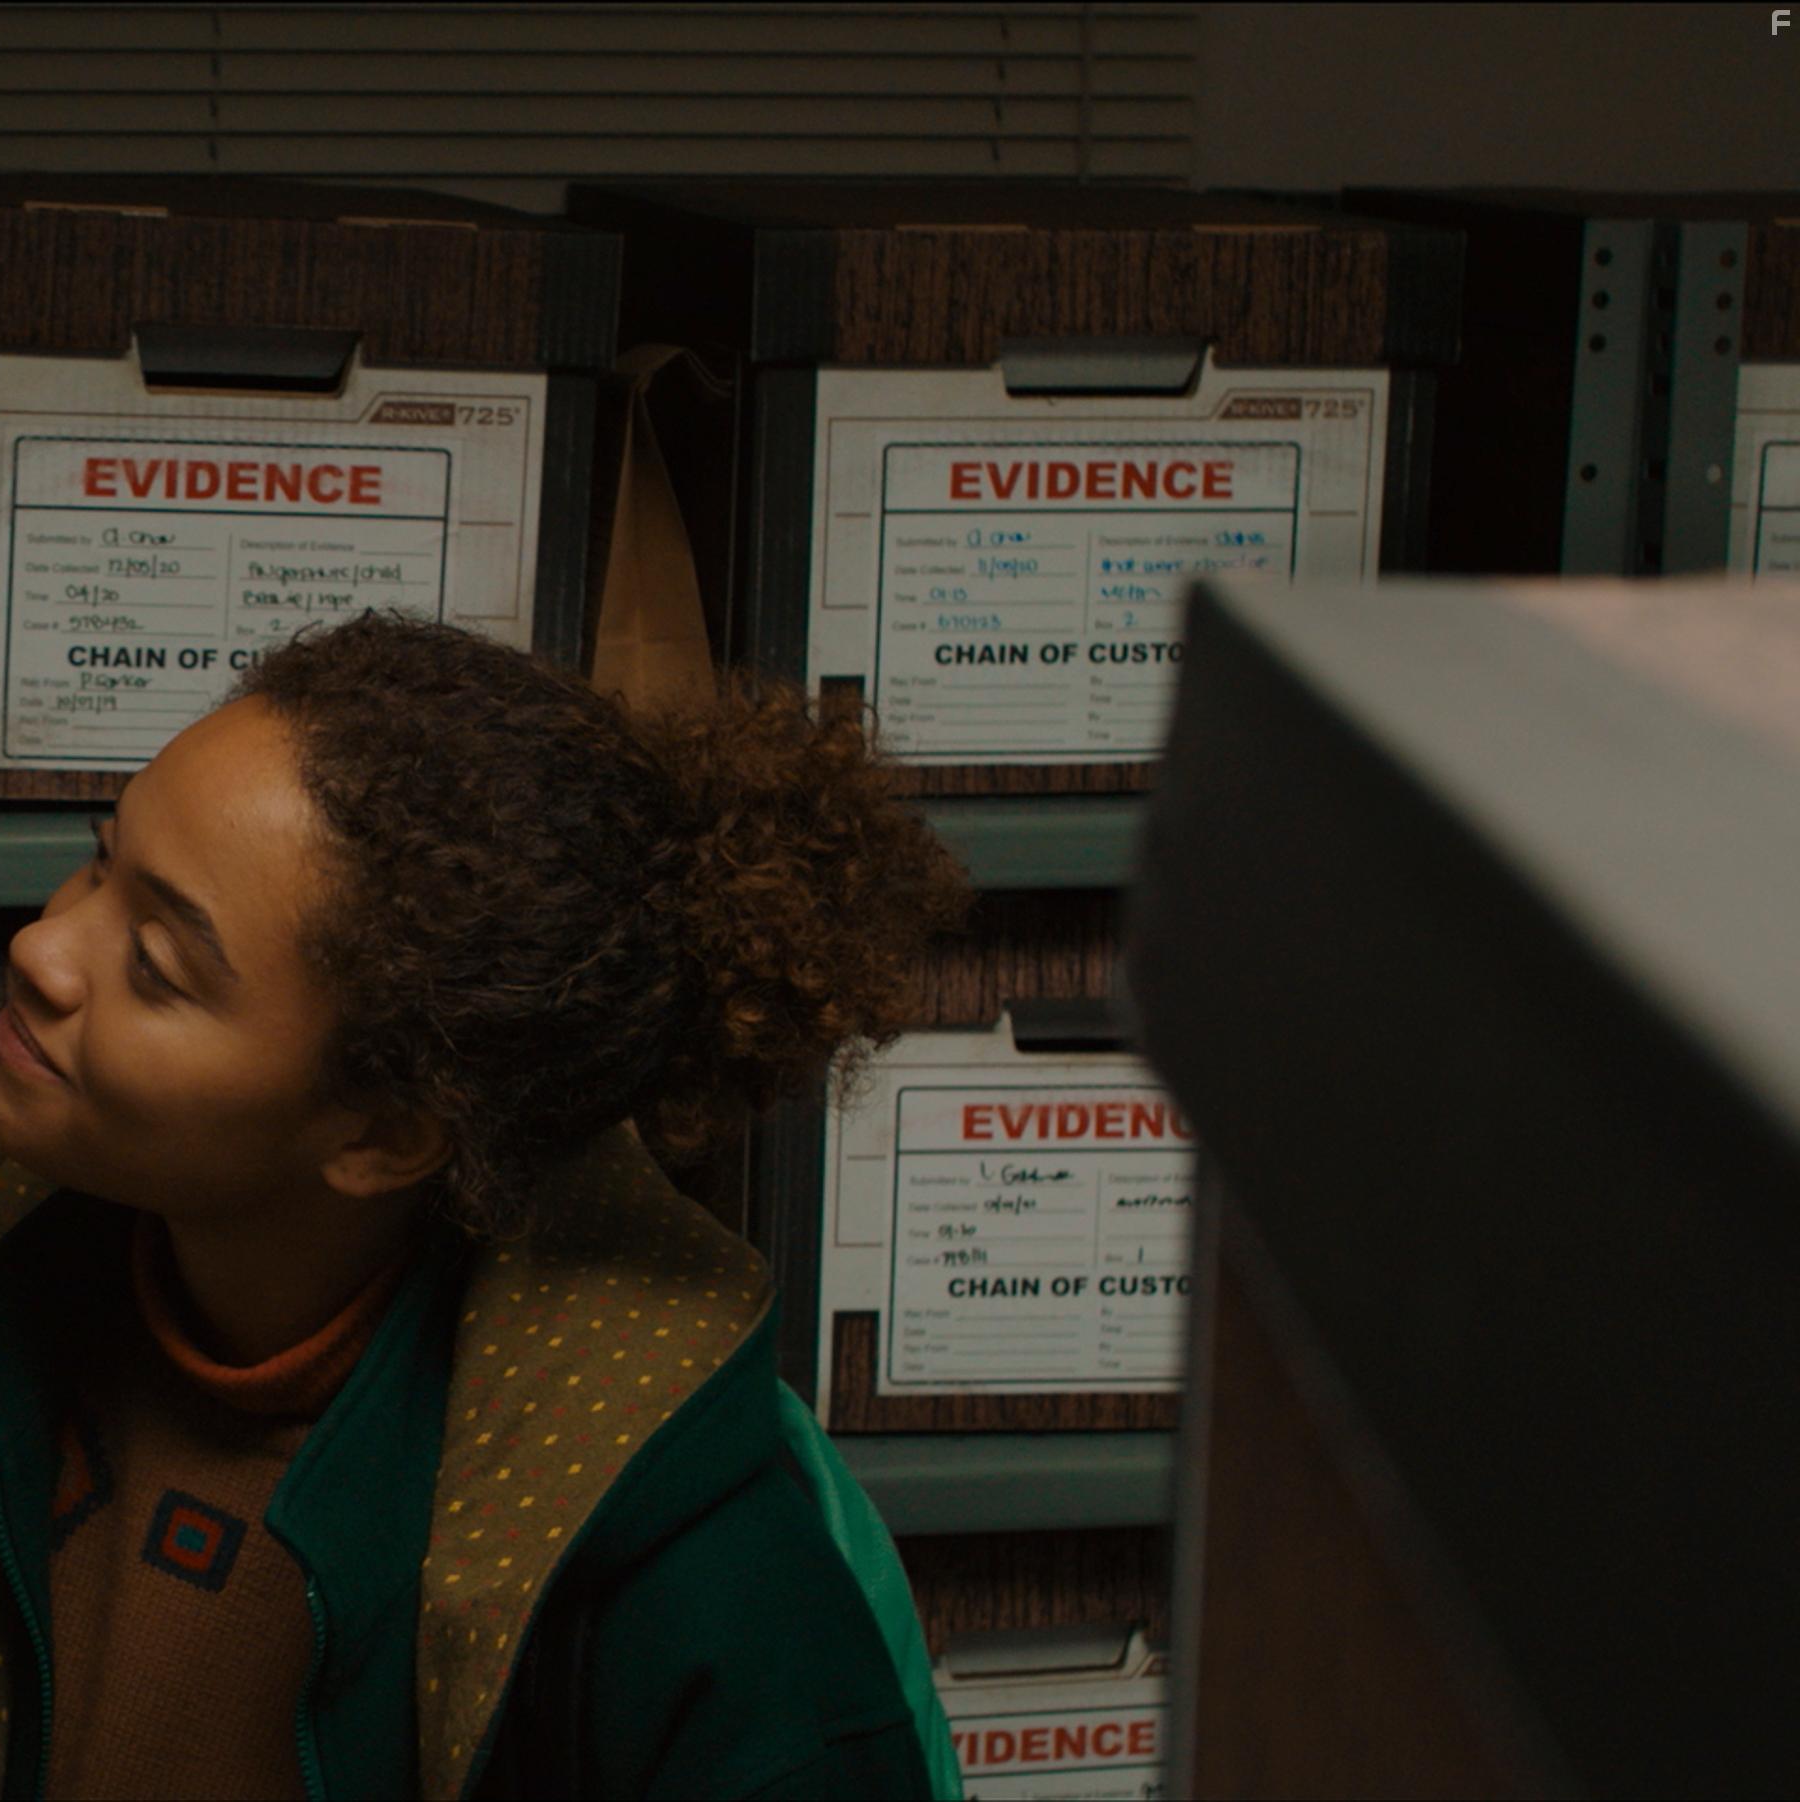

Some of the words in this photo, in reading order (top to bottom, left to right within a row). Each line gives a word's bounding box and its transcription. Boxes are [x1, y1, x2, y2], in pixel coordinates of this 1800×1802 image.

[84, 457, 382, 504] EVIDENCE
[950, 460, 1235, 500] EVIDENCE
[67, 645, 166, 669] CHAIN
[178, 648, 217, 670] OF
[935, 643, 1029, 665] CHAIN
[1040, 643, 1078, 665] OF
[948, 1276, 1041, 1298] CHAIN
[1052, 1276, 1089, 1297] OF
